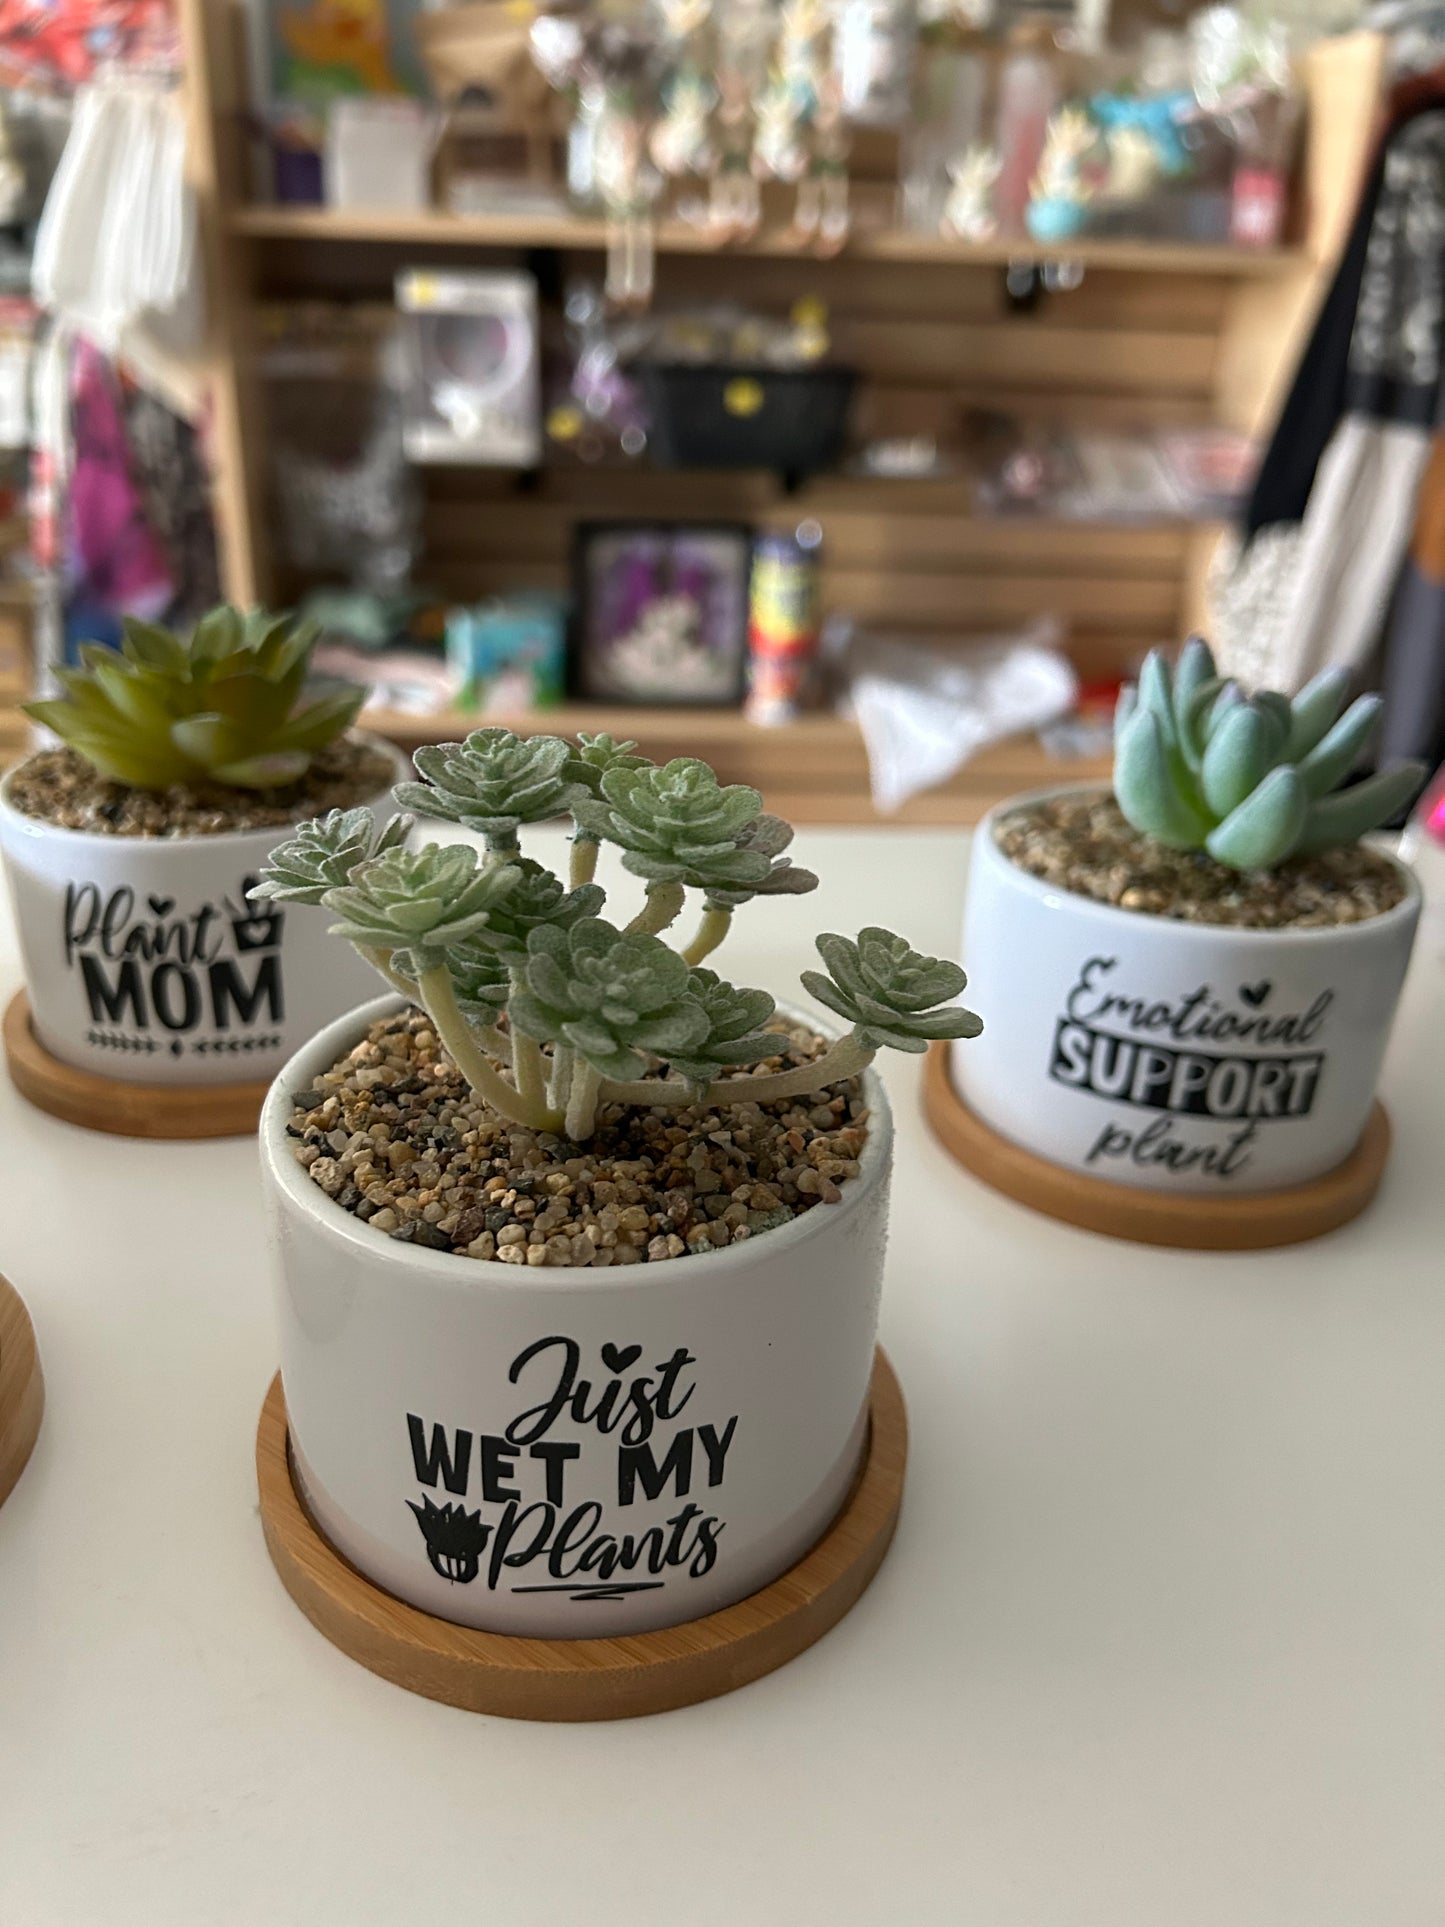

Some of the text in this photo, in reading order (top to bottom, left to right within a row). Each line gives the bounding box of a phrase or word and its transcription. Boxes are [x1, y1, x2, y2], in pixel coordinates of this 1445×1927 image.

[66, 880, 225, 966] Plant
[80, 953, 285, 1030] MOM
[1066, 955, 1334, 1044] Emotional
[1054, 1023, 1321, 1115] SUPPORT
[1085, 1114, 1257, 1178] plant
[505, 1335, 696, 1446] Just
[406, 1412, 738, 1508] WET MY
[487, 1500, 726, 1590] Plants
